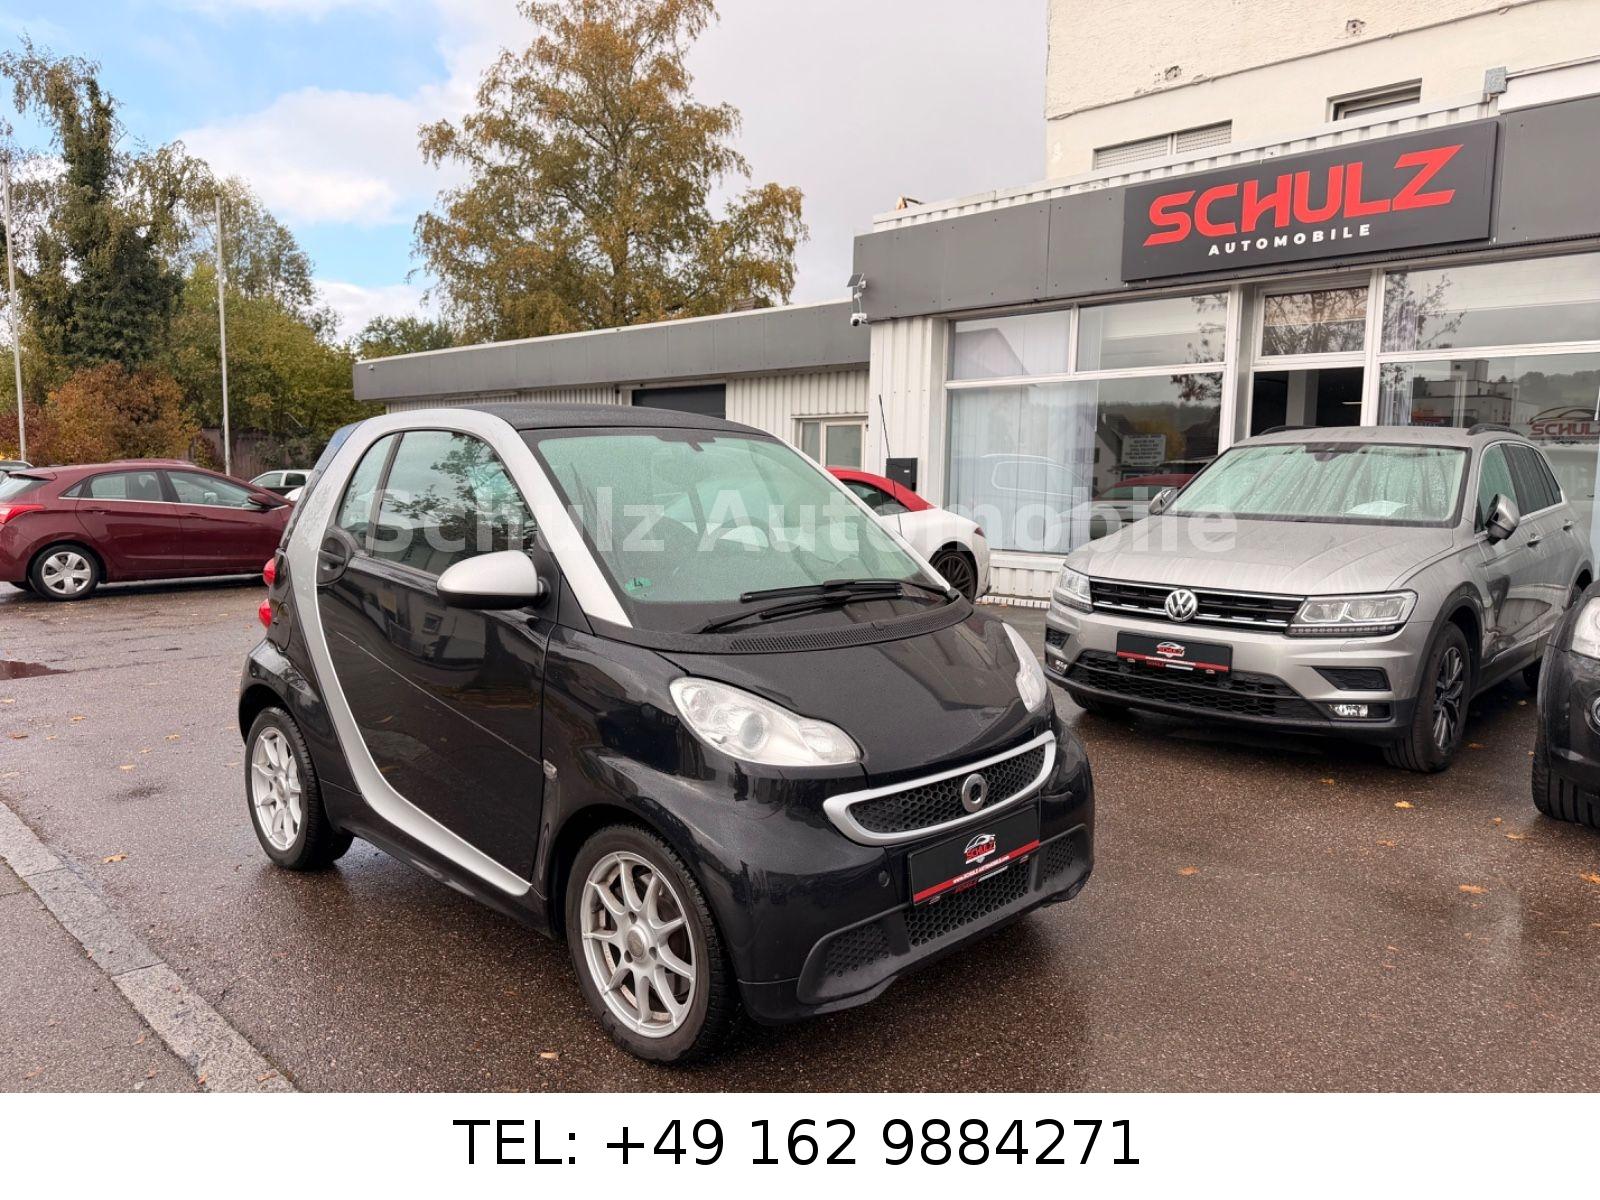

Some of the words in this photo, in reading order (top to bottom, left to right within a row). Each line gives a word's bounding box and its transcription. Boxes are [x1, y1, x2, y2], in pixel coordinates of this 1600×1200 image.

[1143, 144, 1465, 247] SCHULZ
[1208, 223, 1371, 256] AUTOMOBILE
[1529, 423, 1600, 436] SCHUL
